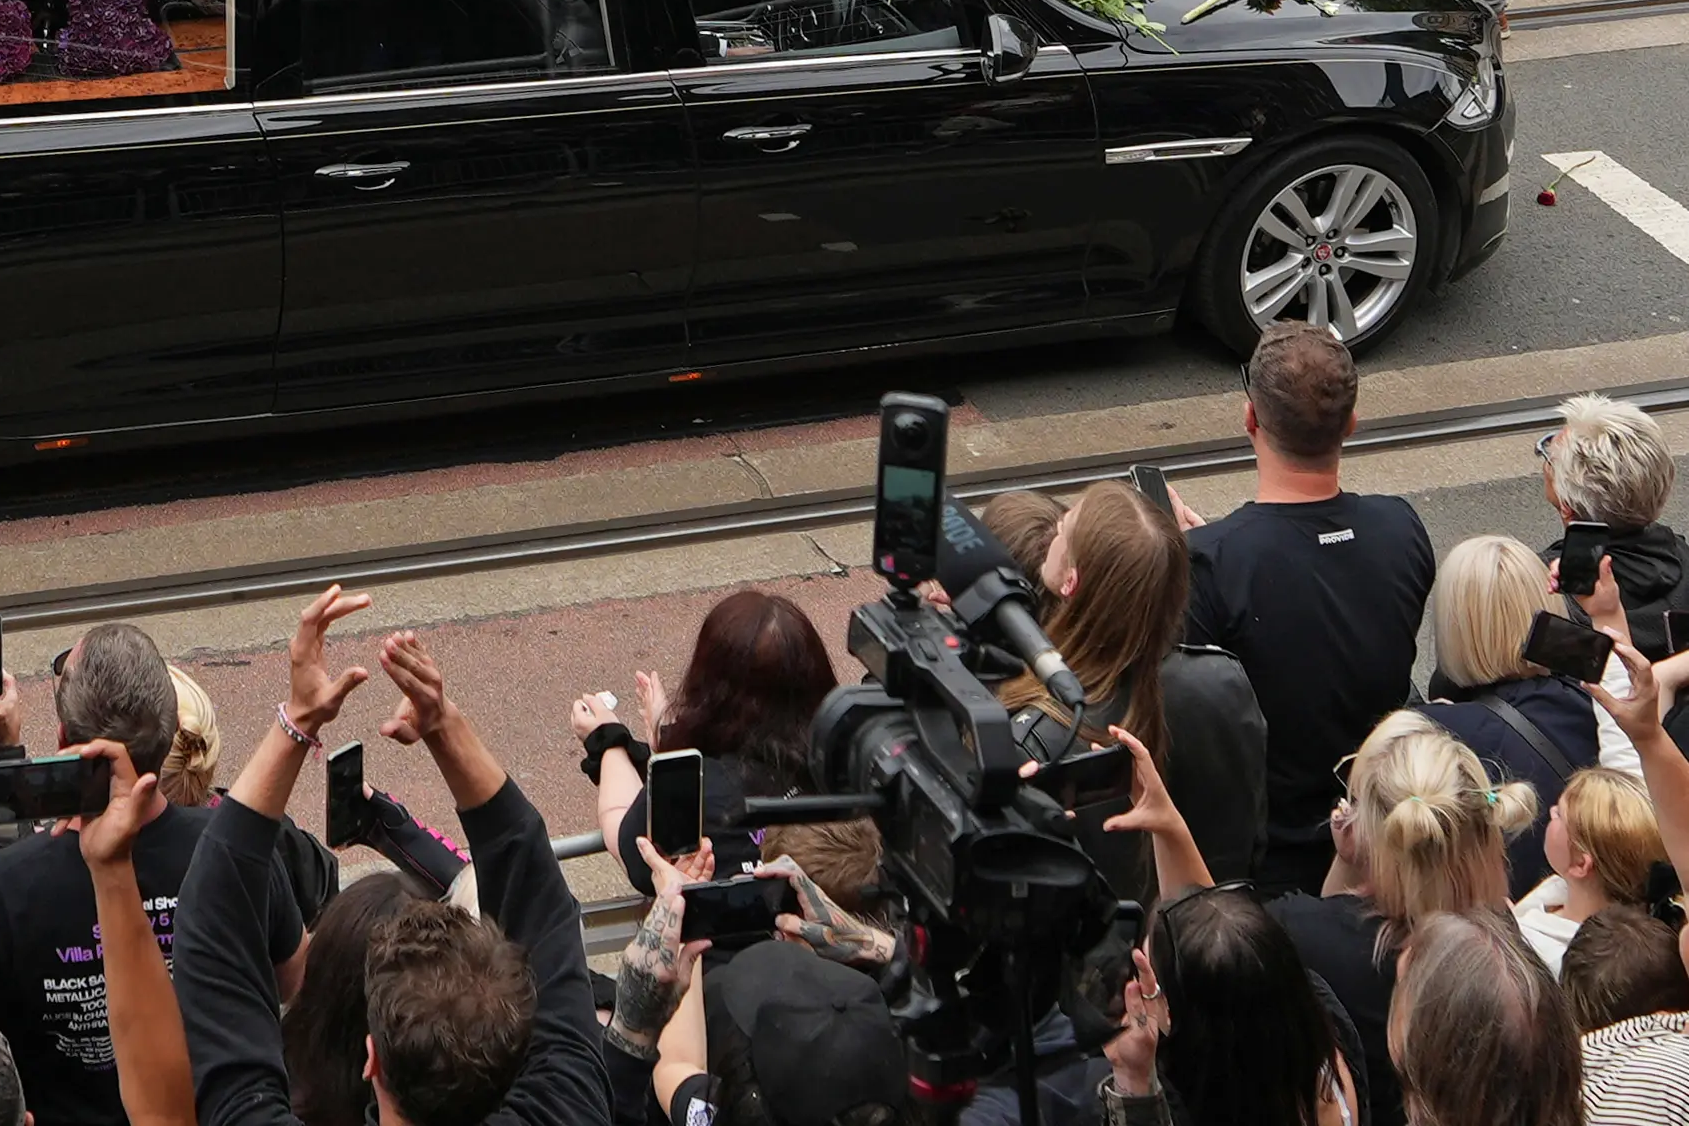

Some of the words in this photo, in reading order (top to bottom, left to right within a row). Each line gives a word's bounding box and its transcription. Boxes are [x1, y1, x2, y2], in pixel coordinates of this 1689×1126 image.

[154, 897, 179, 911] Sho
[159, 912, 170, 927] 5
[56, 944, 93, 964] Villa
[44, 977, 87, 991] BLACK
[80, 998, 108, 1013] TOO
[72, 1012, 83, 1022] IN
[68, 1020, 109, 1032] ANTHRA
